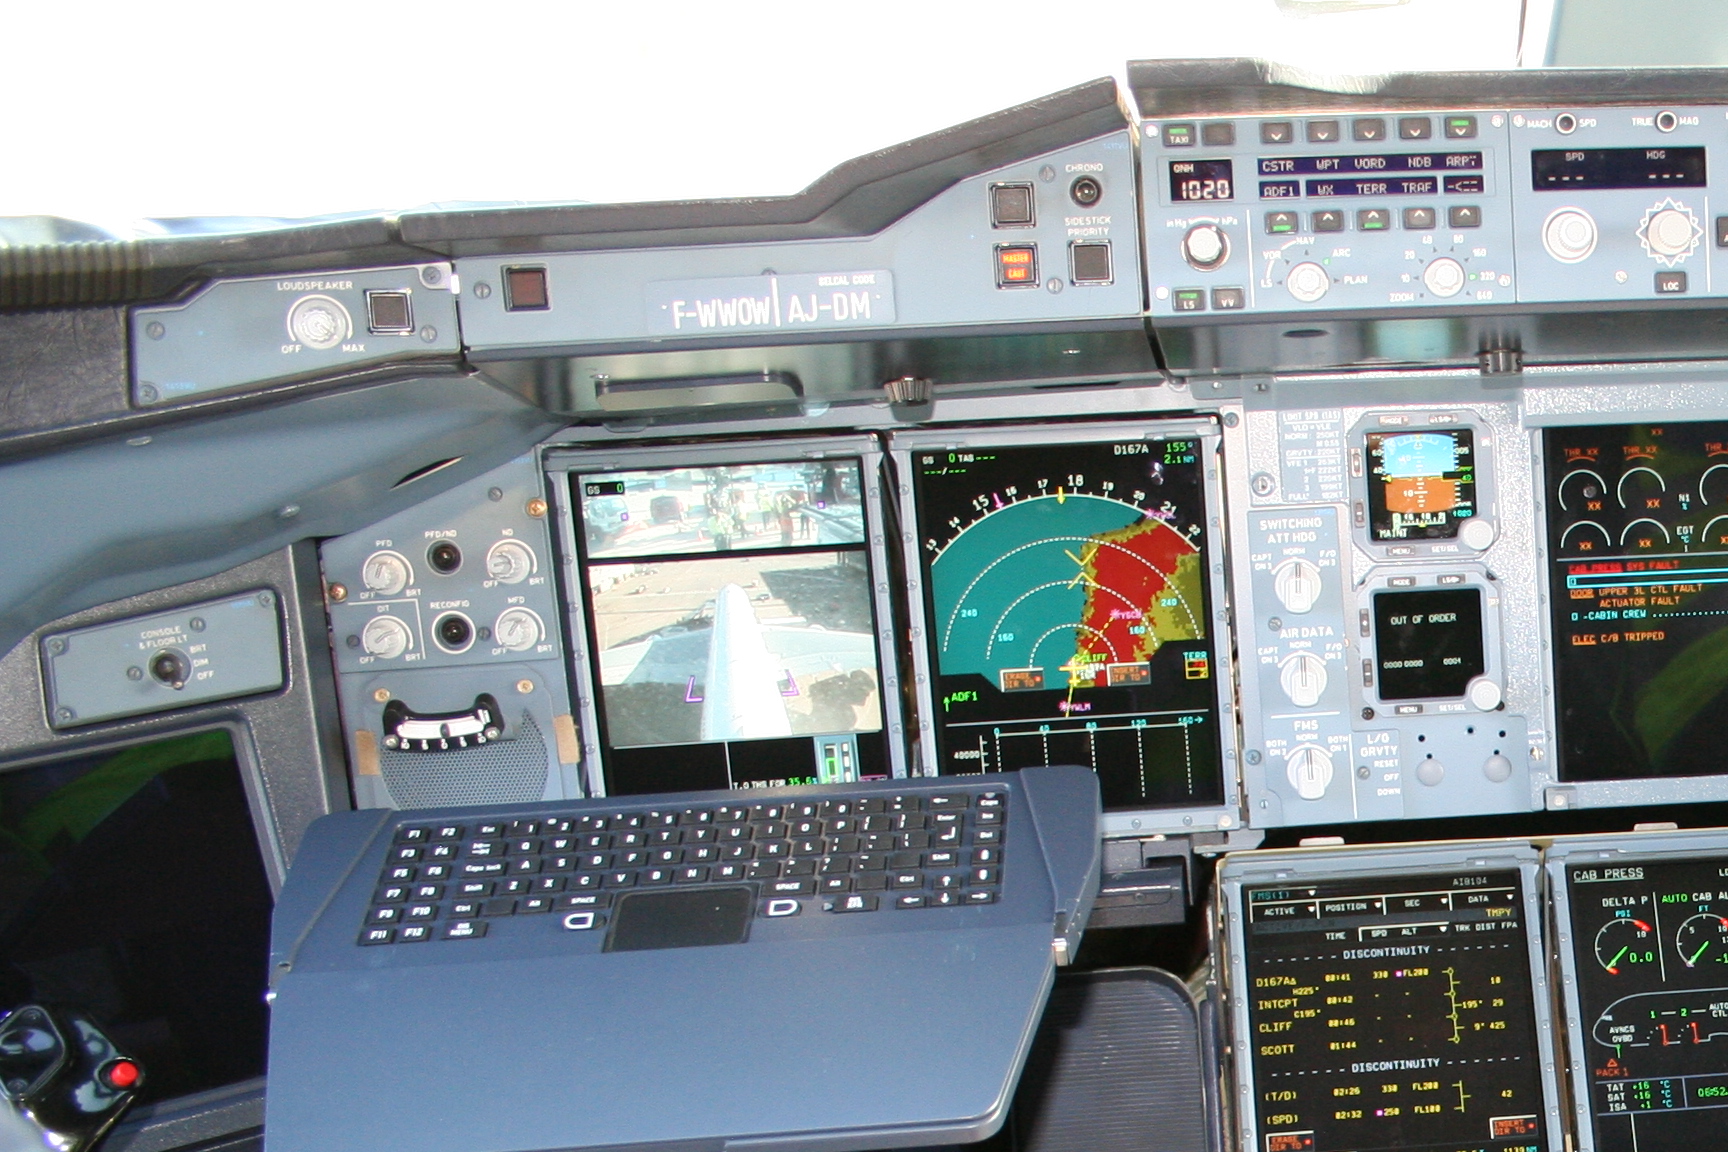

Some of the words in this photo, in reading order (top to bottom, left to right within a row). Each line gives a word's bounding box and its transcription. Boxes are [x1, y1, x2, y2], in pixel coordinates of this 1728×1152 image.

[1632, 118, 1653, 126] TRUE
[1170, 136, 1188, 144] TAXI
[1065, 163, 1103, 172] CHRONO
[1262, 161, 1294, 171] CSTR
[1316, 159, 1340, 170] WPT
[1354, 158, 1386, 169] VORD
[1408, 156, 1432, 167] NDB
[1179, 180, 1230, 199] 1020
[1264, 186, 1294, 196] ADF1
[1356, 183, 1387, 194] TERR
[1402, 182, 1432, 193] TRAF
[1064, 216, 1111, 225] SIDESTICK
[1068, 228, 1109, 236] PRIORITY
[1344, 275, 1368, 284] PLAN
[276, 280, 352, 291] LOUDSPEAKER
[673, 296, 770, 329] F-WWOW
[789, 291, 871, 323] AJ-DM
[281, 344, 301, 354] OFF
[342, 342, 366, 353] MAX
[1114, 444, 1149, 456] D167A
[1067, 474, 1084, 487] 18
[1260, 518, 1323, 530] SWITCHING
[1268, 532, 1291, 544] ATT
[1293, 531, 1316, 543] HDG
[1599, 587, 1630, 596] UPPER
[1651, 585, 1669, 594] CTL
[1673, 583, 1703, 593] FAULT
[430, 600, 469, 609] RECONFIG
[1599, 598, 1646, 608] ACTUATOR
[1651, 596, 1680, 605] FAULT
[1390, 616, 1408, 625] OUT
[1412, 615, 1423, 624] OF
[1623, 610, 1647, 619] CREW
[141, 625, 182, 639] CONSOLE
[1280, 628, 1299, 639] AIR
[1302, 627, 1334, 638] DATA
[1624, 631, 1665, 641] TRIPPED
[197, 670, 214, 680] OFF
[951, 690, 978, 702] ADF1
[1294, 720, 1318, 731] FMS
[1360, 747, 1398, 756] GRVTY
[1573, 870, 1599, 881] CAB
[1604, 868, 1644, 880] PRESS
[1602, 897, 1635, 907] DELTA
[1662, 894, 1688, 903] AUTO
[1692, 893, 1713, 902] CAB
[1263, 906, 1295, 915] ACTIVE
[1325, 901, 1367, 911] POSITION
[1343, 946, 1430, 959] DISCONTINUITY
[1261, 1045, 1295, 1056] SCOTT
[1351, 1058, 1441, 1073] DISCONTINUITY
[1606, 1082, 1624, 1091] TAT
